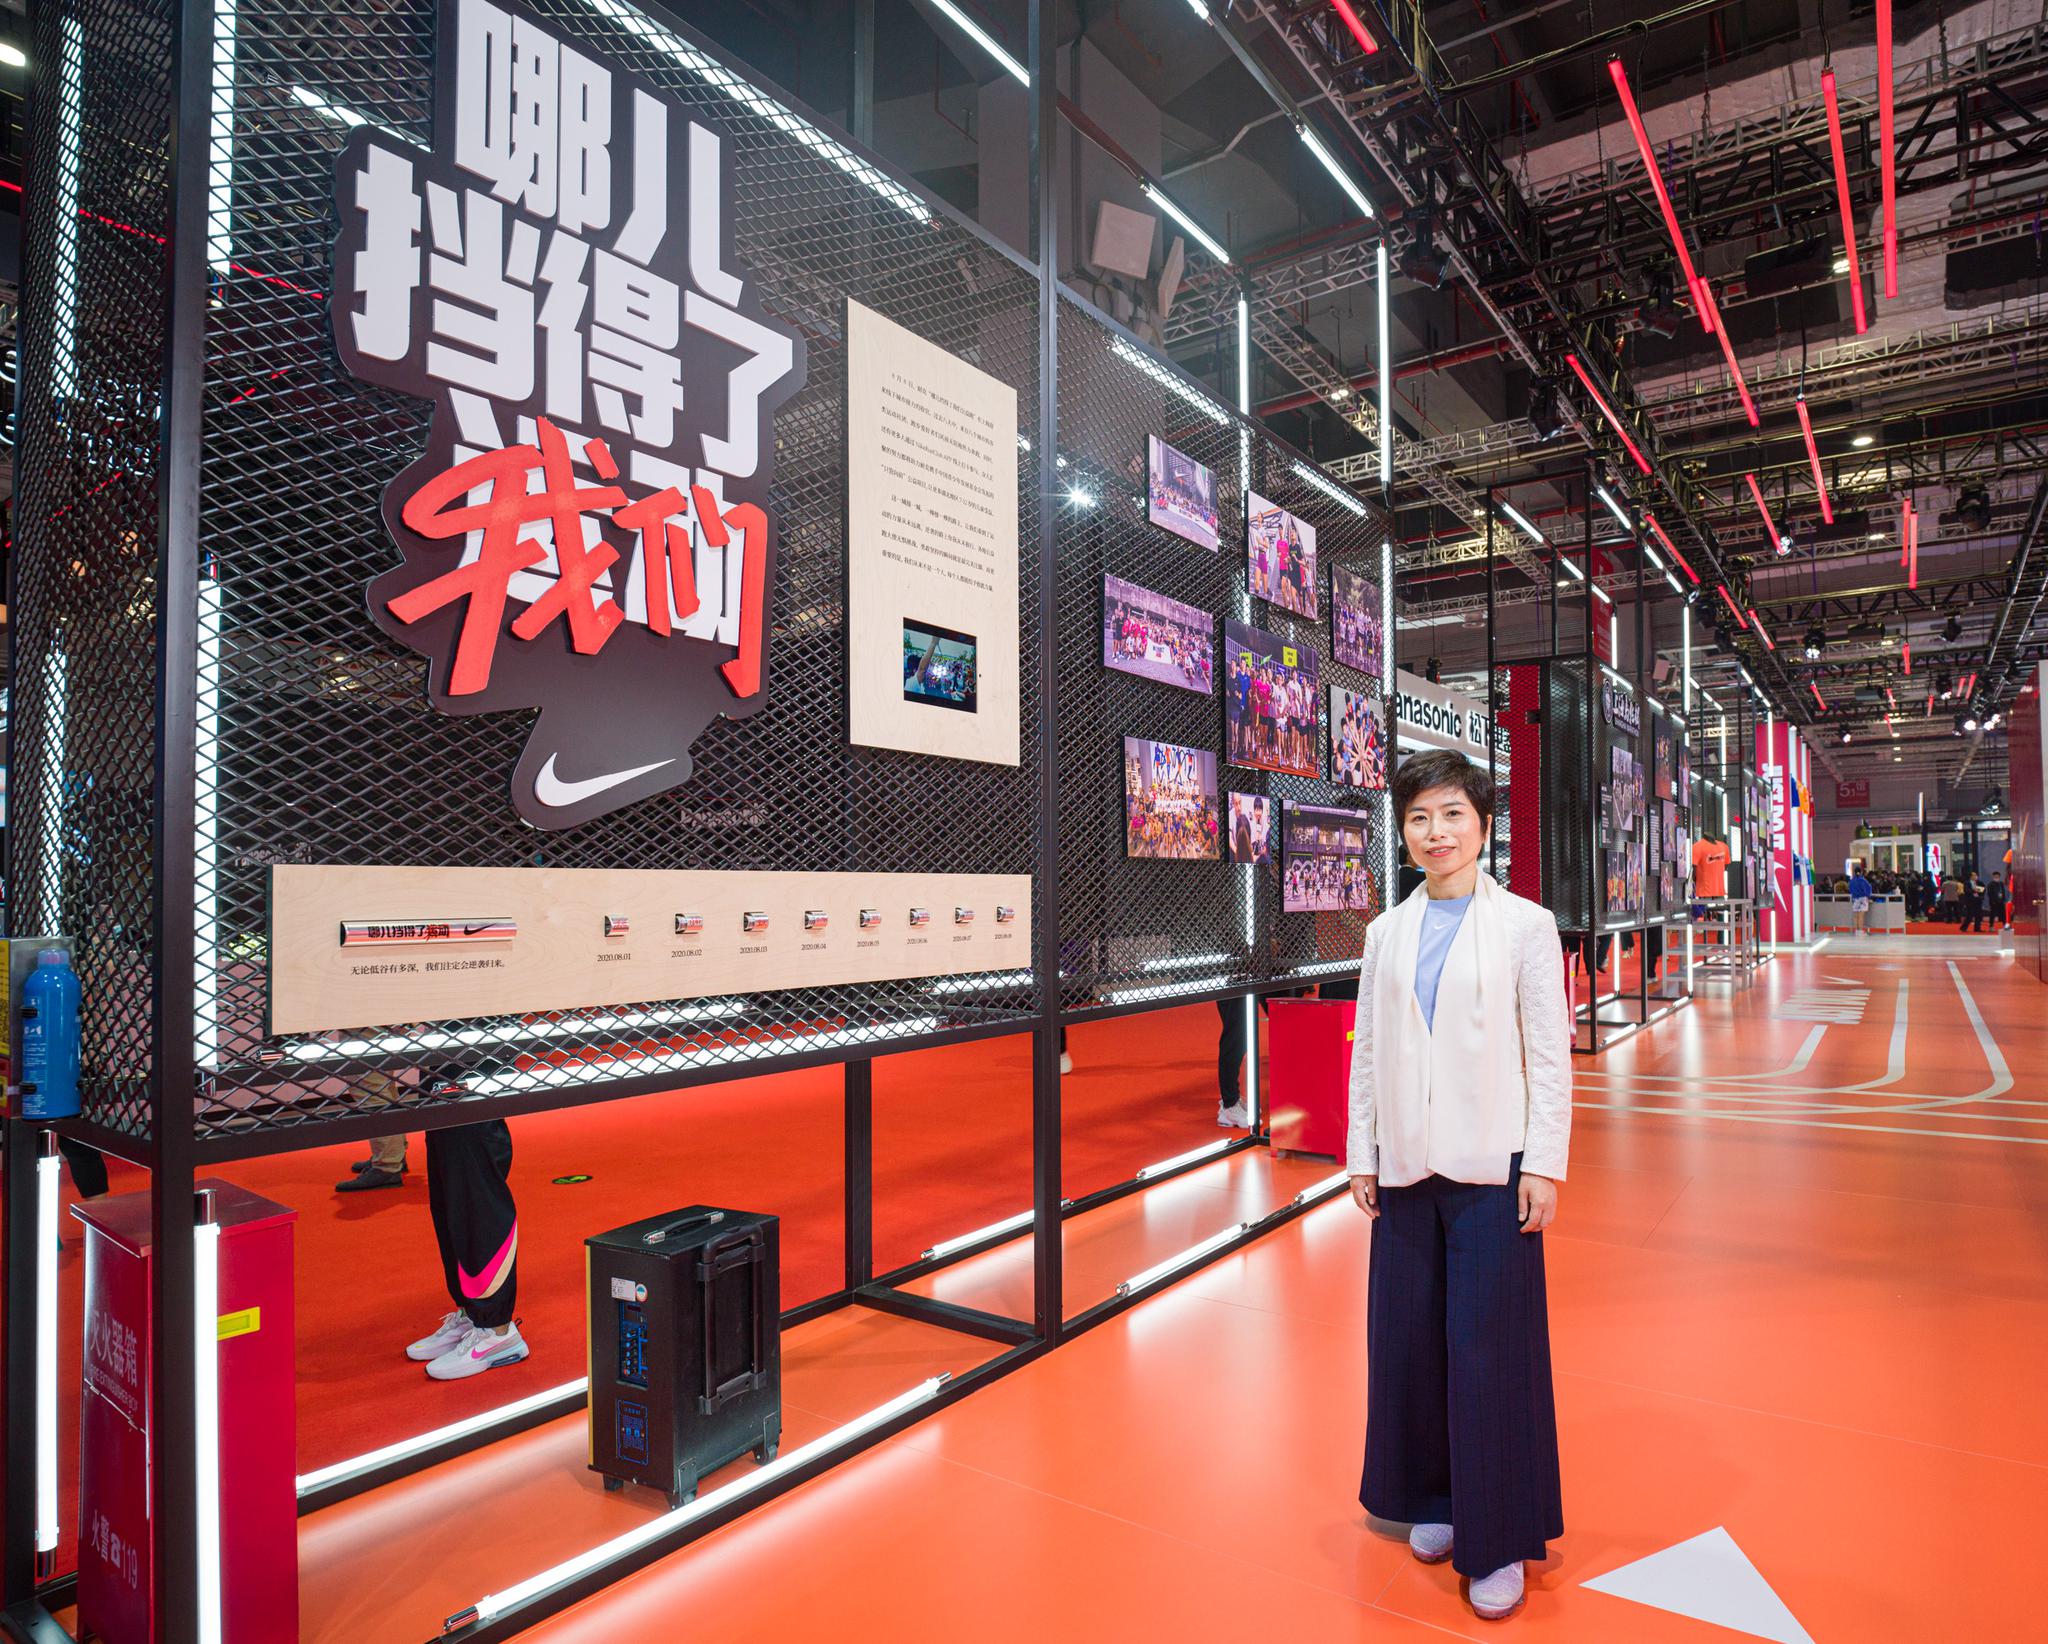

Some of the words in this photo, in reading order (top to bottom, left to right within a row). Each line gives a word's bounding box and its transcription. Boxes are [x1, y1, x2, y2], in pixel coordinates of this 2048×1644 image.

[454, 0, 744, 308] 哪儿
[353, 143, 794, 478] 挡得了
[386, 416, 768, 698] 我们
[1396, 692, 1462, 738] anasonic
[351, 959, 505, 976] 无论低谷有多深,我们注定会逆袭归来。
[597, 953, 631, 962] 2020.08.01
[671, 949, 703, 958] 2020.08.02
[90, 1310, 138, 1388] 灭火器箱
[91, 1509, 110, 1562] 火警
[122, 1538, 138, 1590] 119
